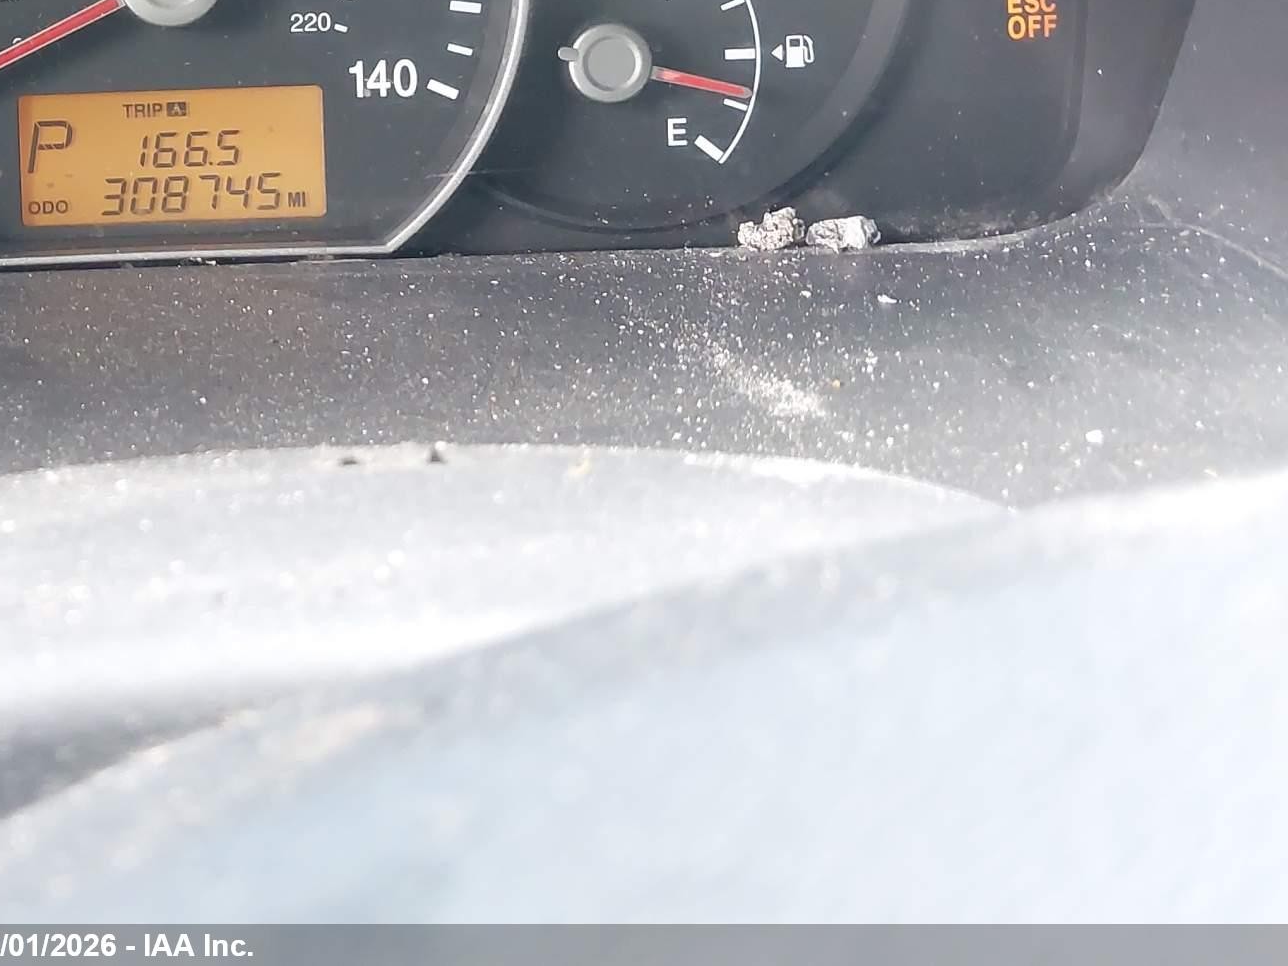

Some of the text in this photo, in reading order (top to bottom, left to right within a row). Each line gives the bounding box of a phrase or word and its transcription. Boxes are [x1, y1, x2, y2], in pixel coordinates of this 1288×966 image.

[290, 12, 332, 32] 220
[1008, 15, 1057, 39] OFF
[349, 59, 417, 99] 140
[123, 103, 163, 118] TRIP
[27, 120, 73, 174] P
[667, 118, 687, 146] E
[140, 130, 240, 168] 166.5
[28, 172, 306, 216] ODO 308745 MI
